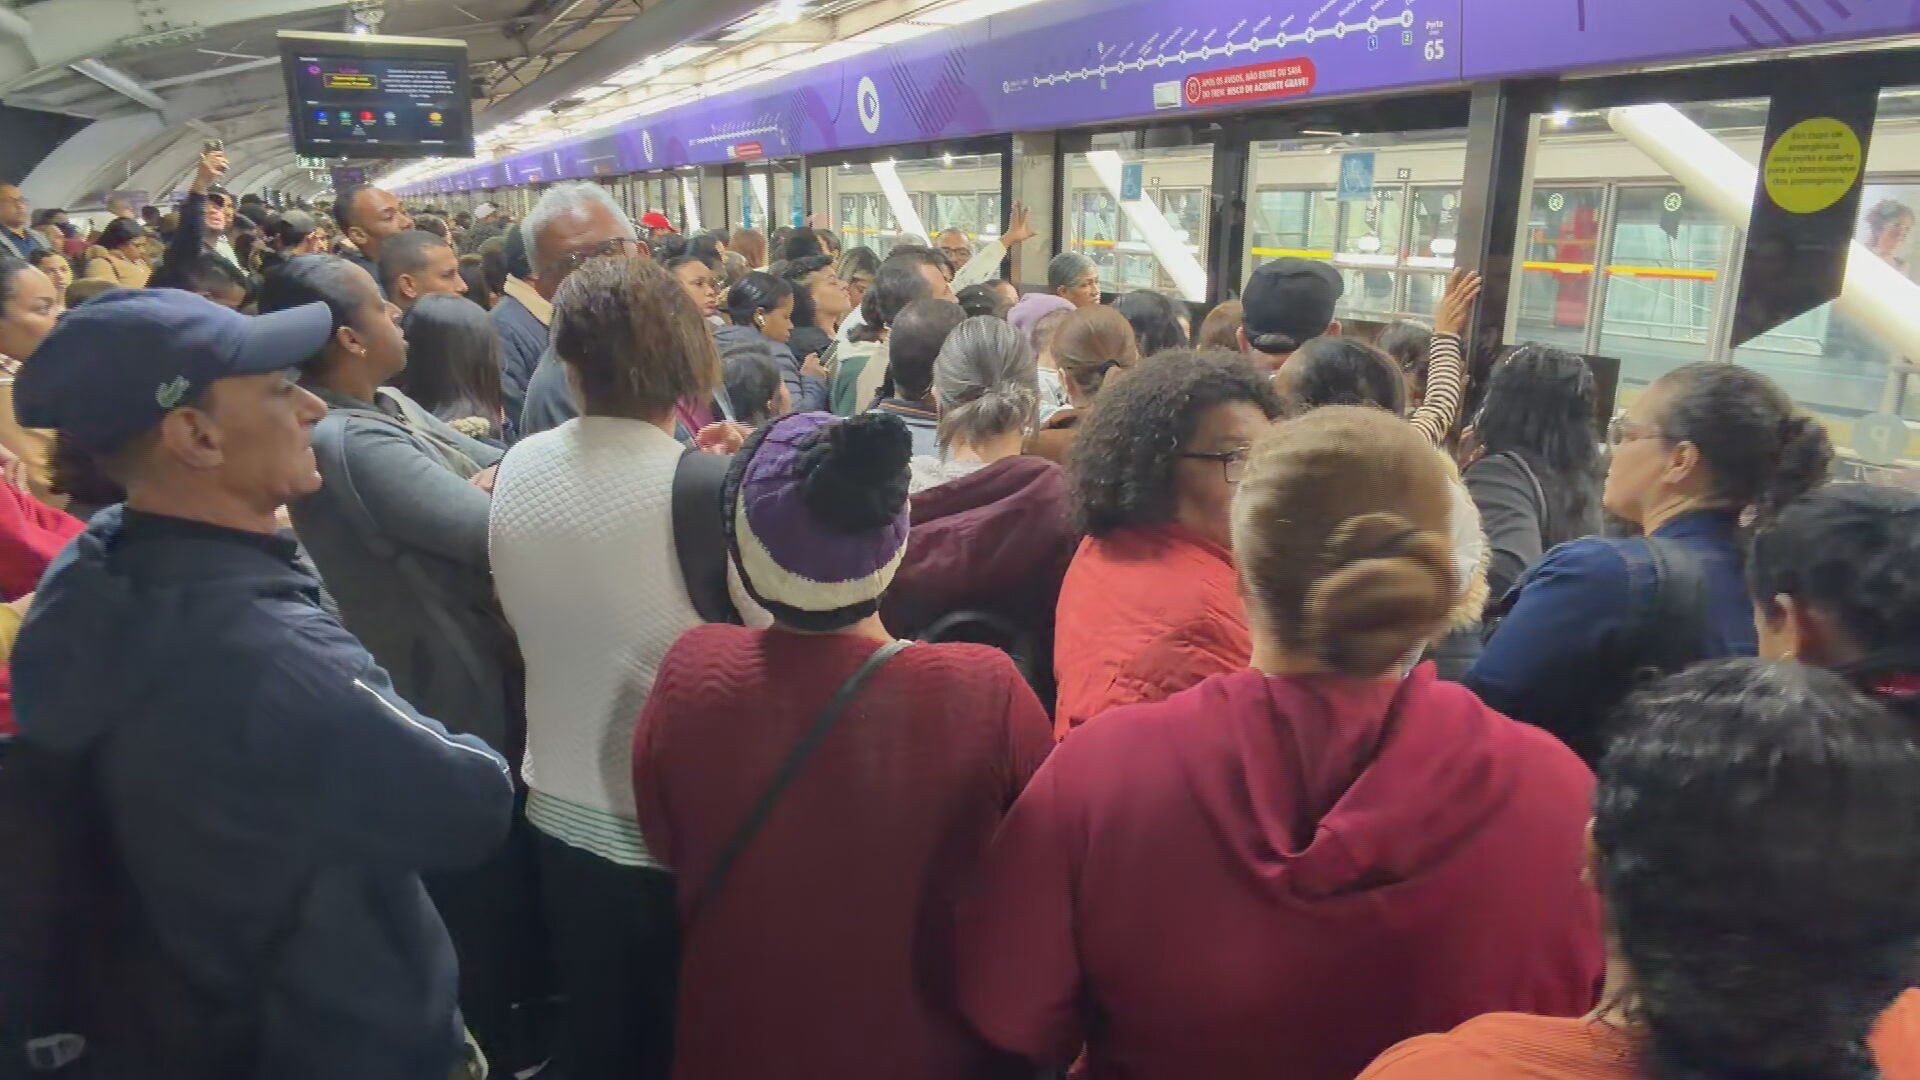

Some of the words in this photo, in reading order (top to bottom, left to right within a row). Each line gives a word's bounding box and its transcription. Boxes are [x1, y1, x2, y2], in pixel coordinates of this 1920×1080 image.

[1424, 39, 1444, 60] 65
[1245, 71, 1257, 81] NÃO
[1258, 69, 1276, 79] ENTRE
[1277, 68, 1287, 77] OU
